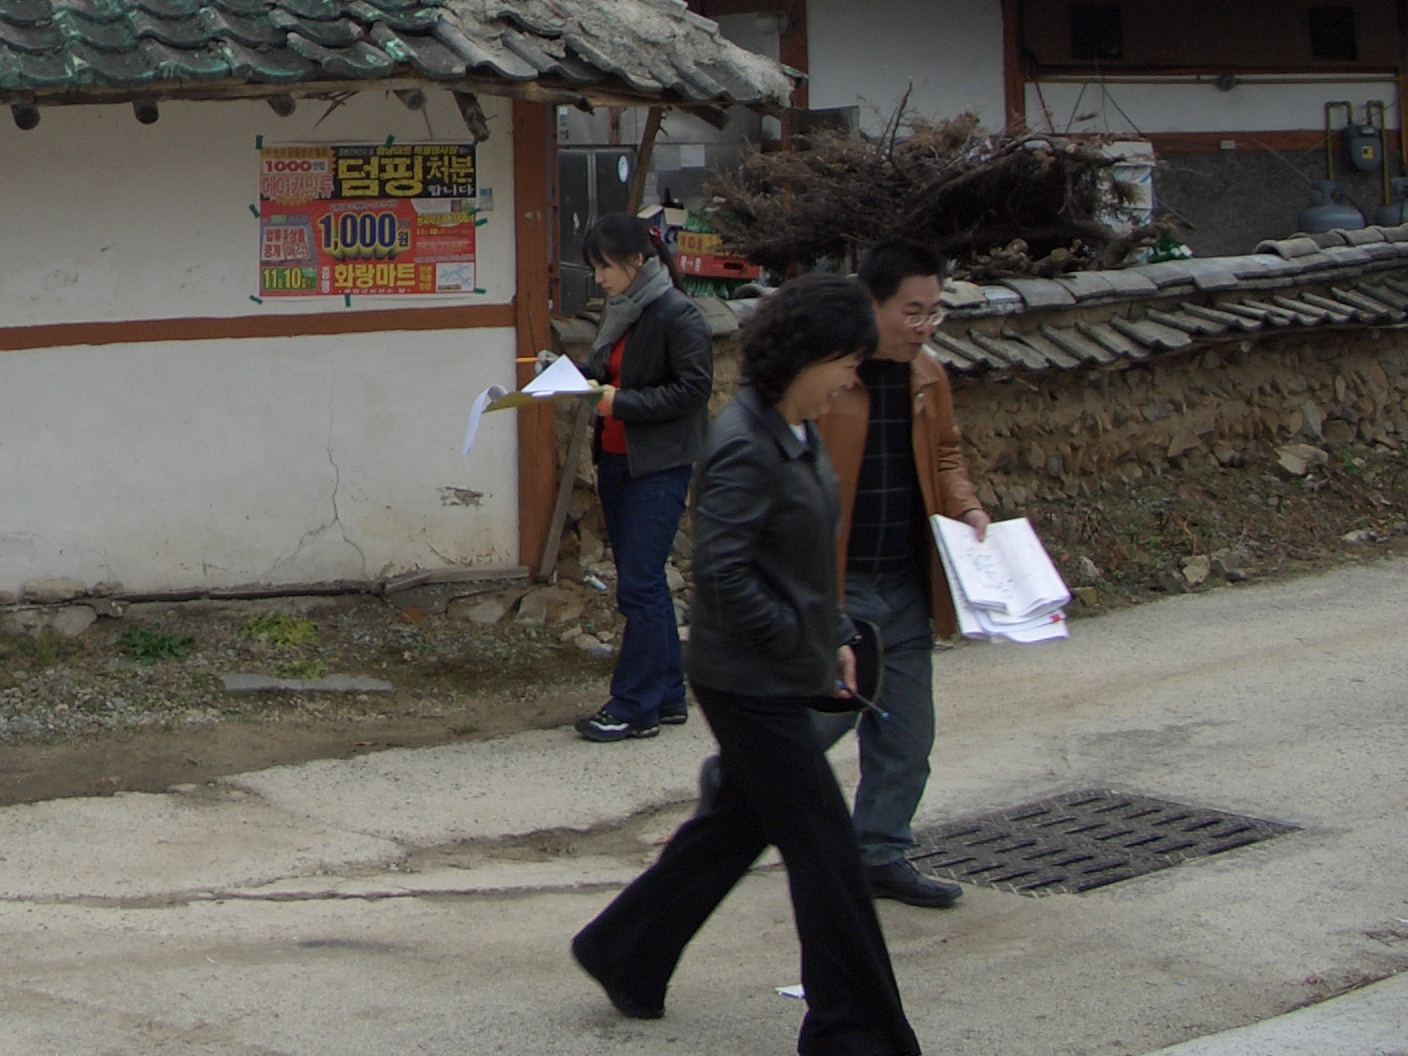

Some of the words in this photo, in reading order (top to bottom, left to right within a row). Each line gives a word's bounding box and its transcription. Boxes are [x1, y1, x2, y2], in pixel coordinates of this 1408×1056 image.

[338, 156, 423, 197] 덤핑
[426, 155, 474, 184] 처분
[427, 184, 474, 196] 합니다
[335, 263, 416, 289] 화랑마트
